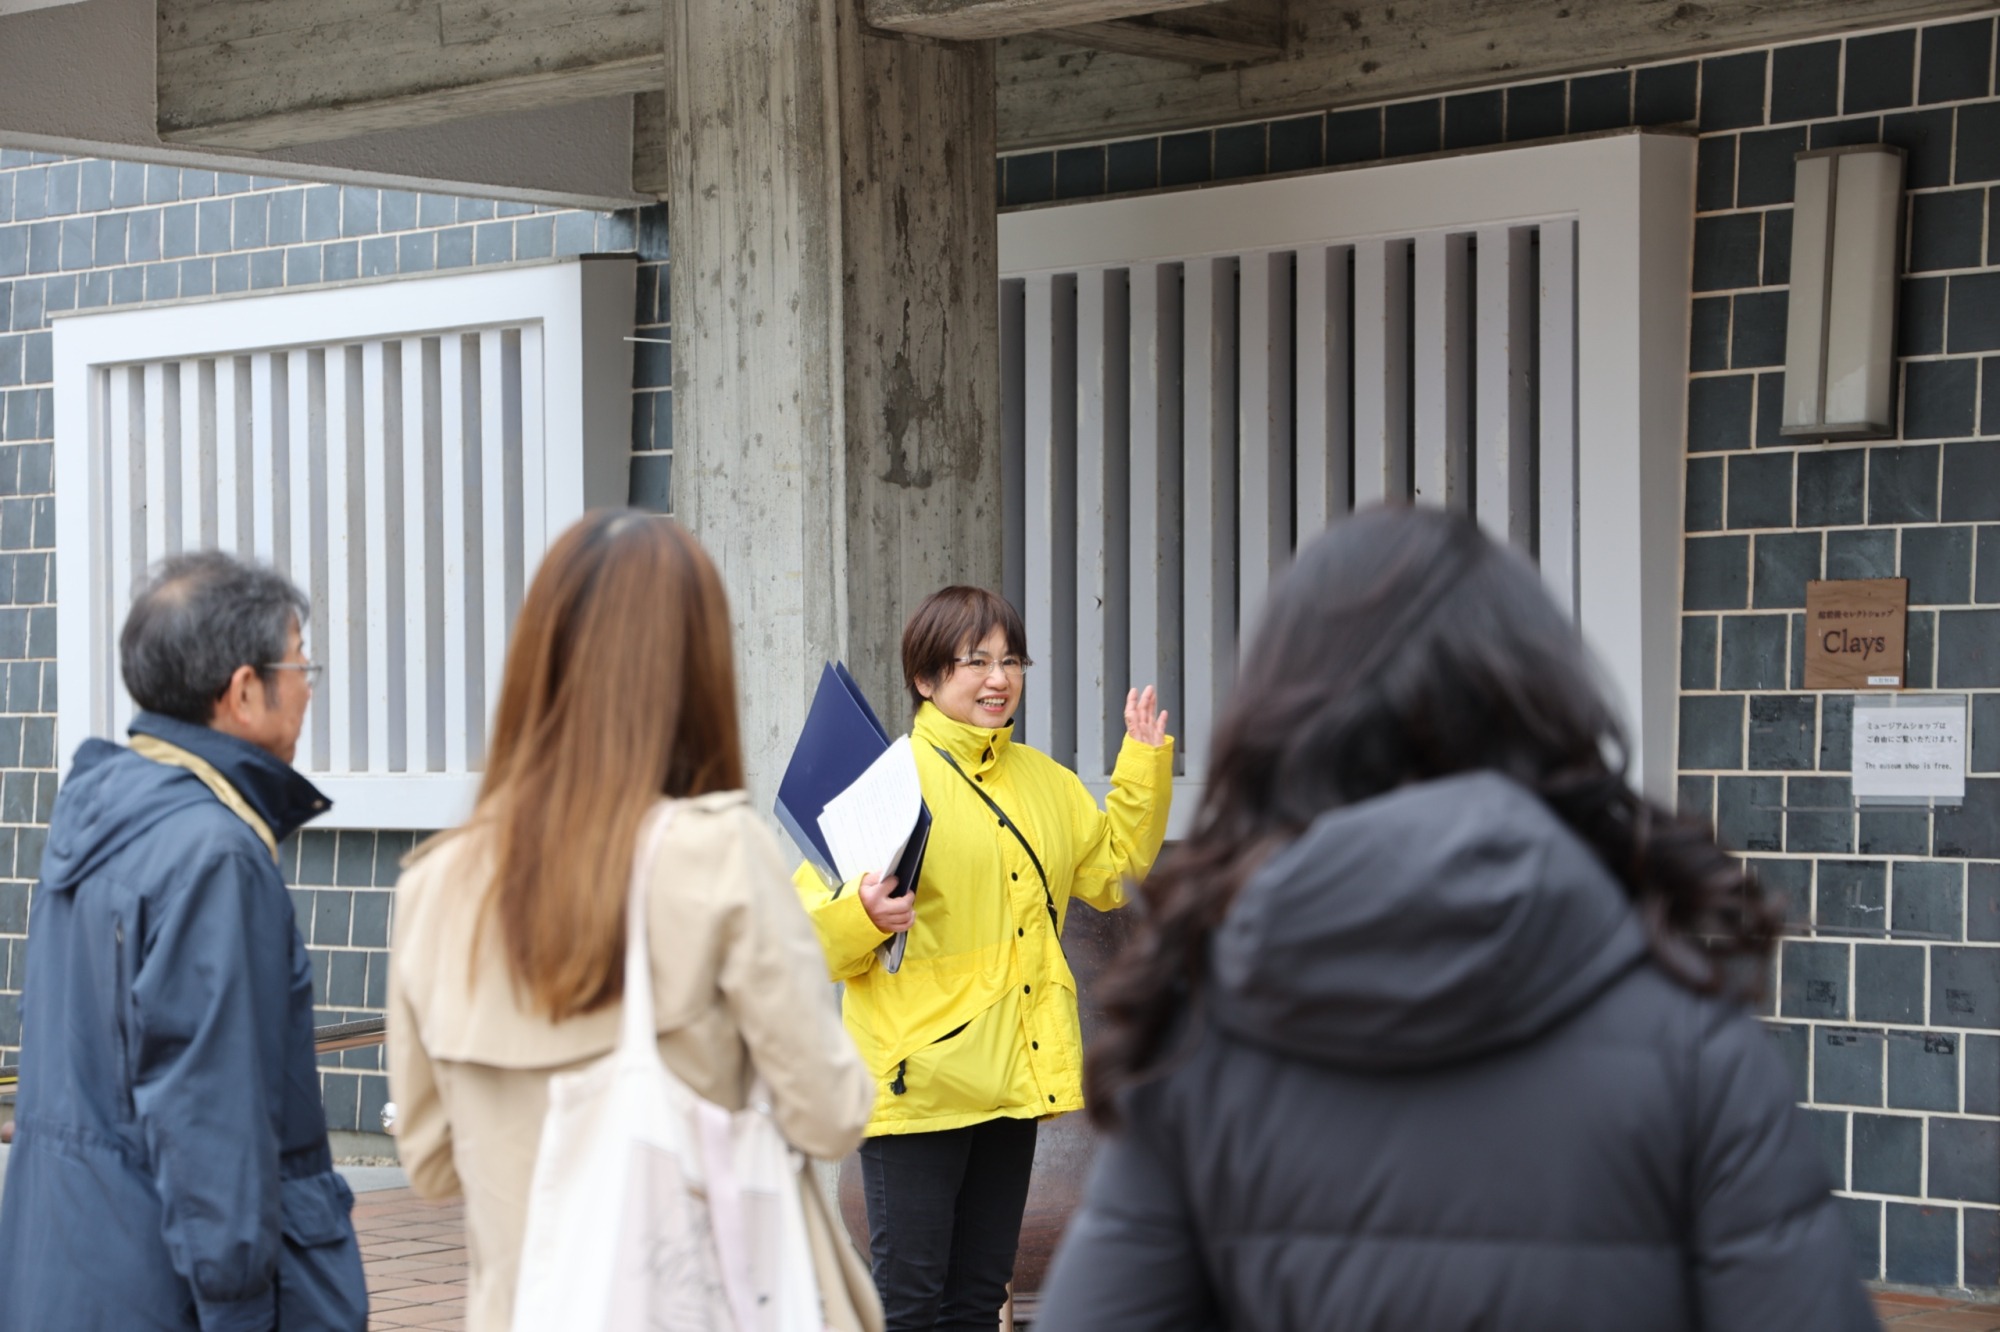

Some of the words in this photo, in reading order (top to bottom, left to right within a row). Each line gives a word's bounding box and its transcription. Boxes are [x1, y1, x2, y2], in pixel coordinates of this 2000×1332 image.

[1823, 628, 1886, 661] Clays
[1867, 721, 1946, 730] ミュージアムショップは
[1866, 735, 1958, 743] ご自由にご覧いただけます。
[1865, 762, 1876, 770] The
[1904, 762, 1920, 770] shop
[1923, 762, 1931, 770] is
[1934, 762, 1952, 770] free.
